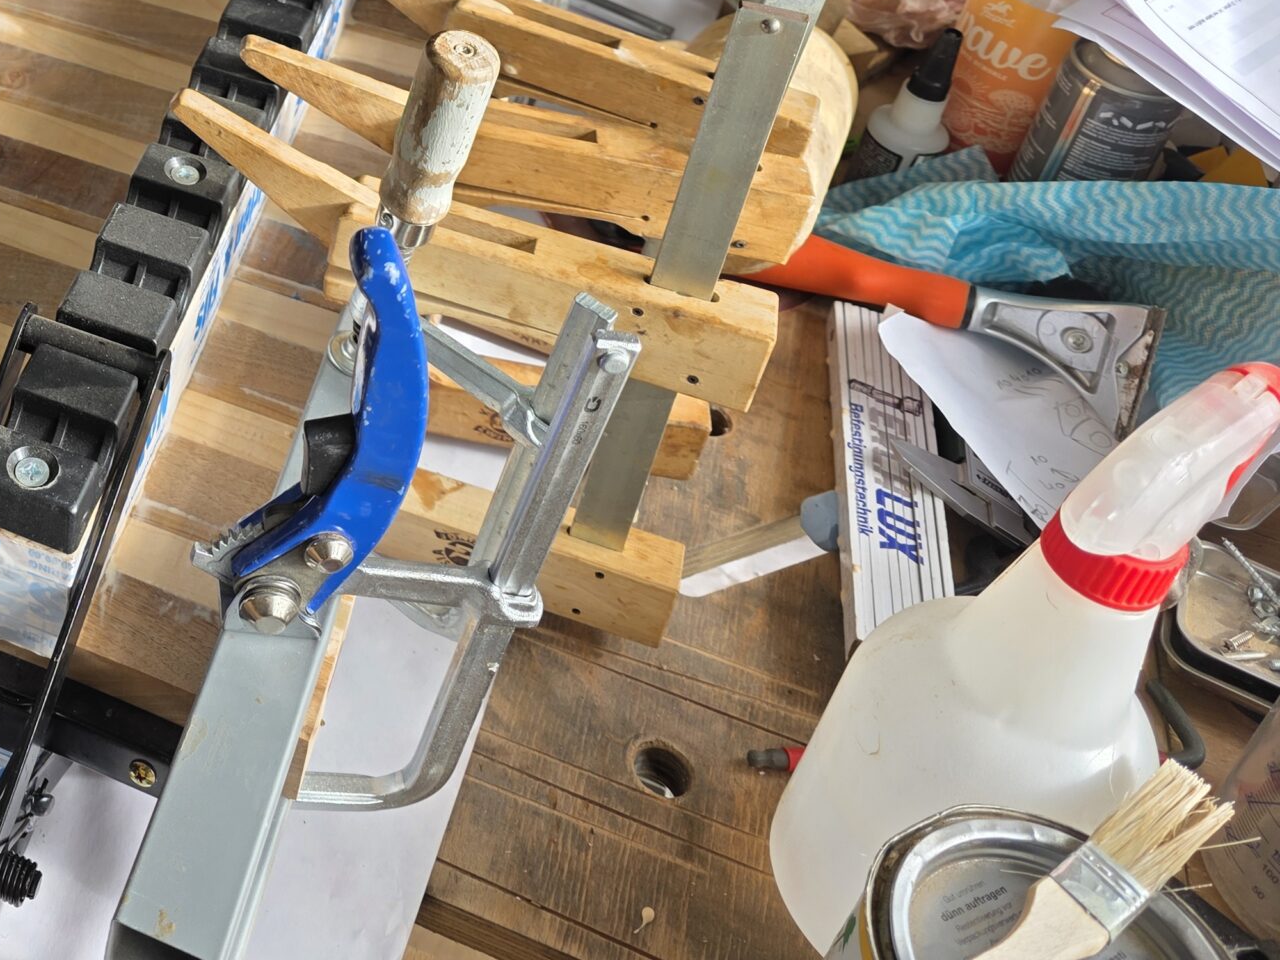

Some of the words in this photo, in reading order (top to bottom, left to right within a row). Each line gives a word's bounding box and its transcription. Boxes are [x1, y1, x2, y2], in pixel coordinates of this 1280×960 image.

[846, 401, 876, 537] Befestigungstechnik
[874, 484, 925, 566] LUX
[940, 904, 966, 922] dünn
[964, 884, 1009, 911] auftragen
